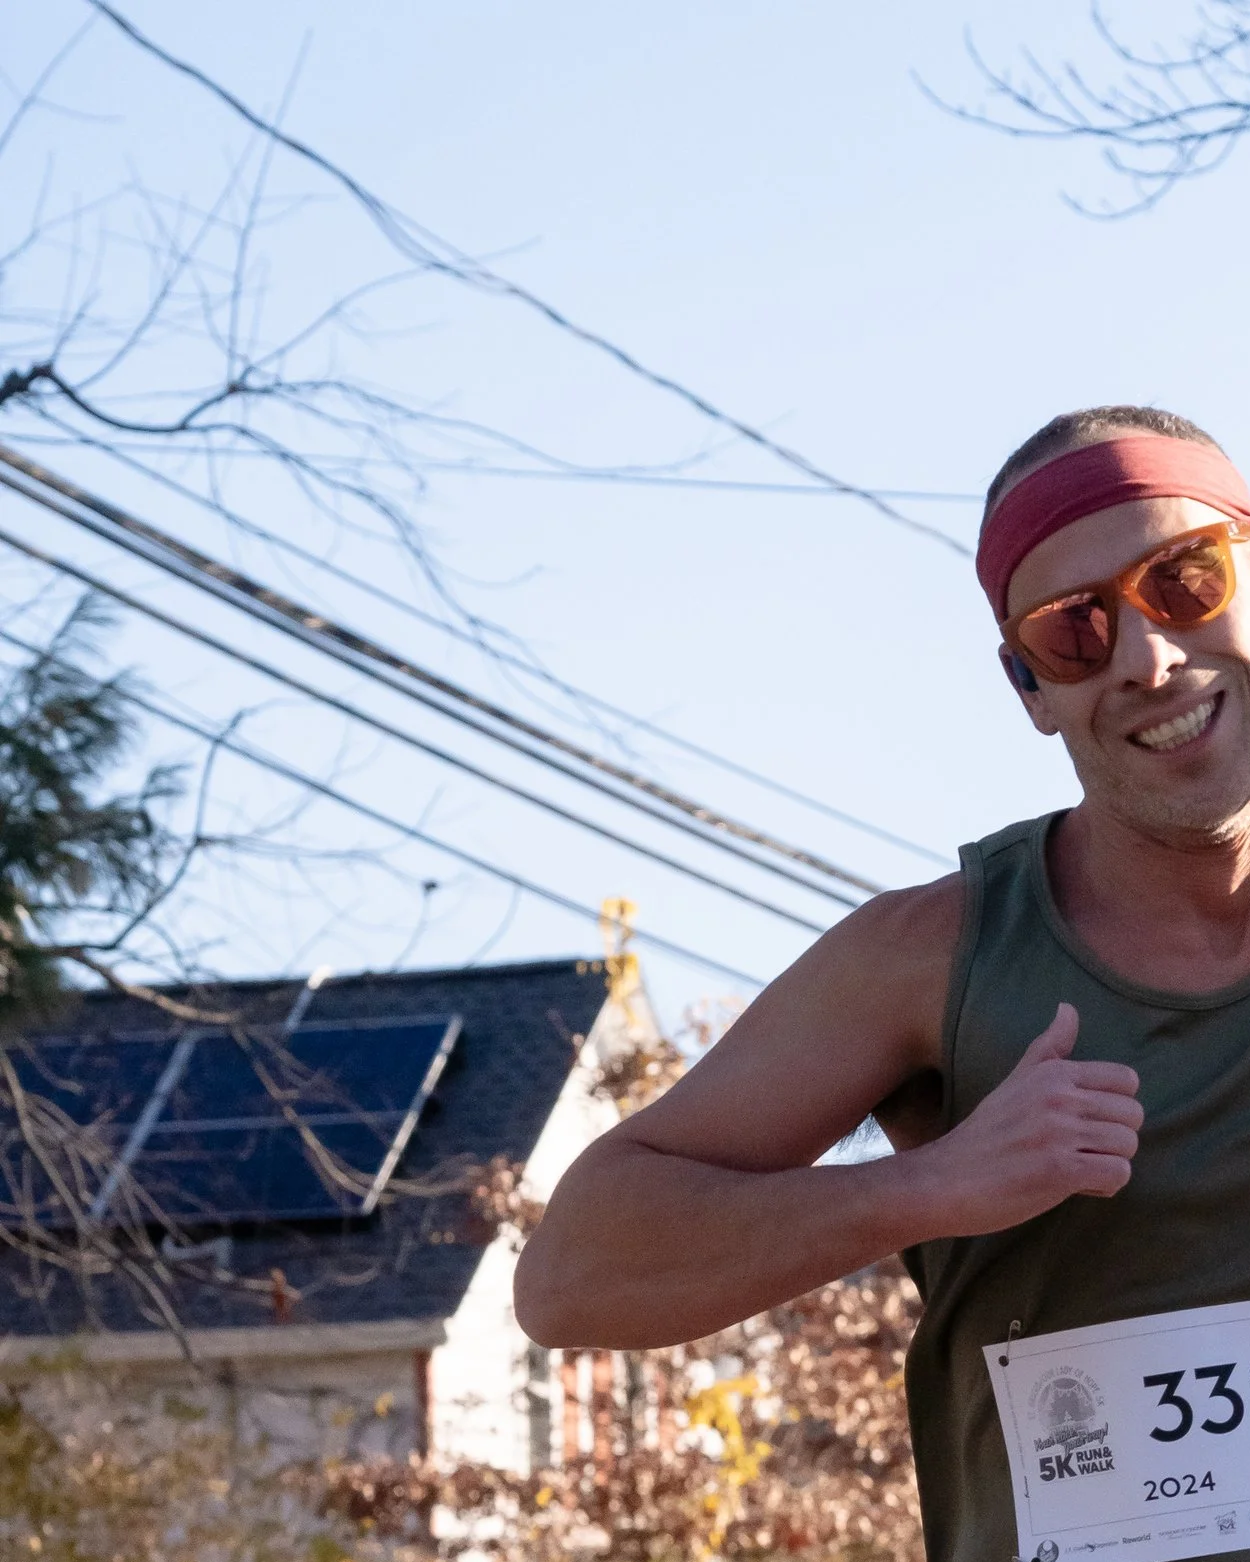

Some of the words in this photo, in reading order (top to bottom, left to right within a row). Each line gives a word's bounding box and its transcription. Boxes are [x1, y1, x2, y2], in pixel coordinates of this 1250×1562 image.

[1039, 1452, 1077, 1482] 5K
[1078, 1458, 1115, 1476] WALK
[1143, 1470, 1216, 1502] 2024
